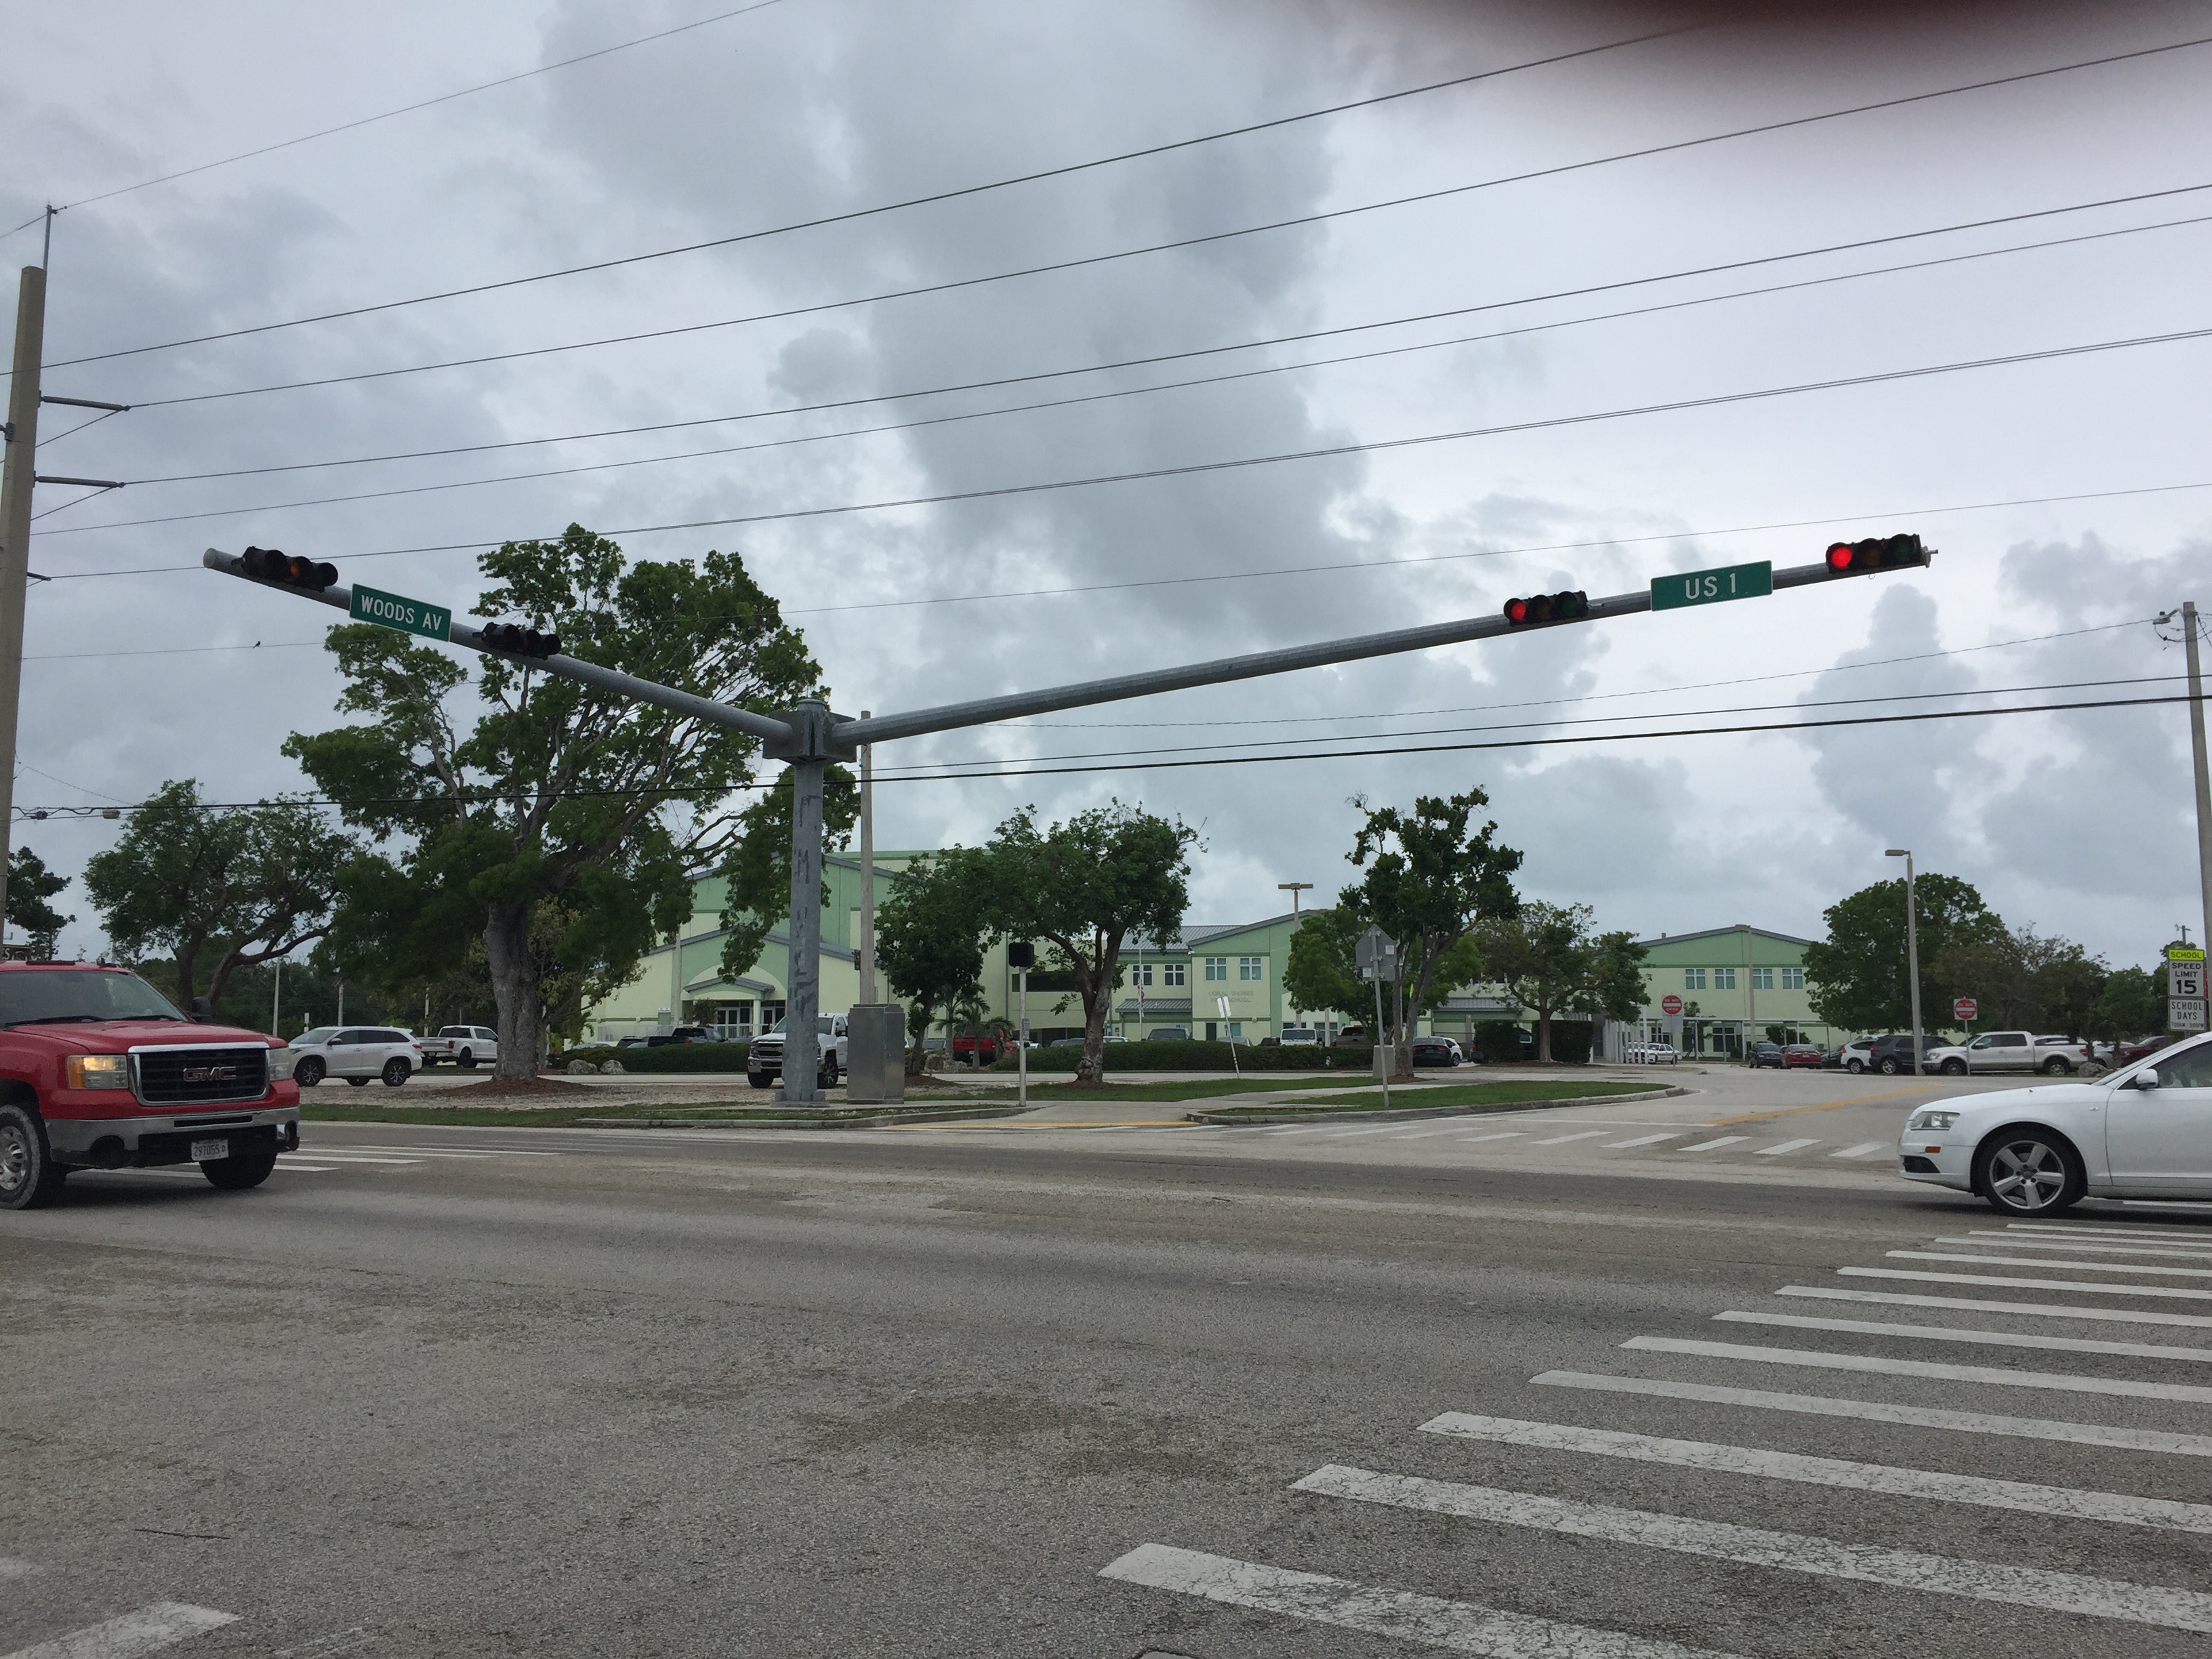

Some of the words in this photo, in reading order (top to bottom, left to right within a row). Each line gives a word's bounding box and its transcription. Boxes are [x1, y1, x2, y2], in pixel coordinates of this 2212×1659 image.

[1685, 575, 1718, 600] US
[1729, 572, 1737, 594] 1
[361, 594, 415, 624] WOODS
[422, 611, 443, 632] AV
[2171, 951, 2202, 959] SCHOOL
[2176, 979, 2197, 994] 15
[2171, 1001, 2203, 1010] SCHOOL
[2177, 1011, 2198, 1021] DAYS
[183, 1066, 237, 1082] GMC
